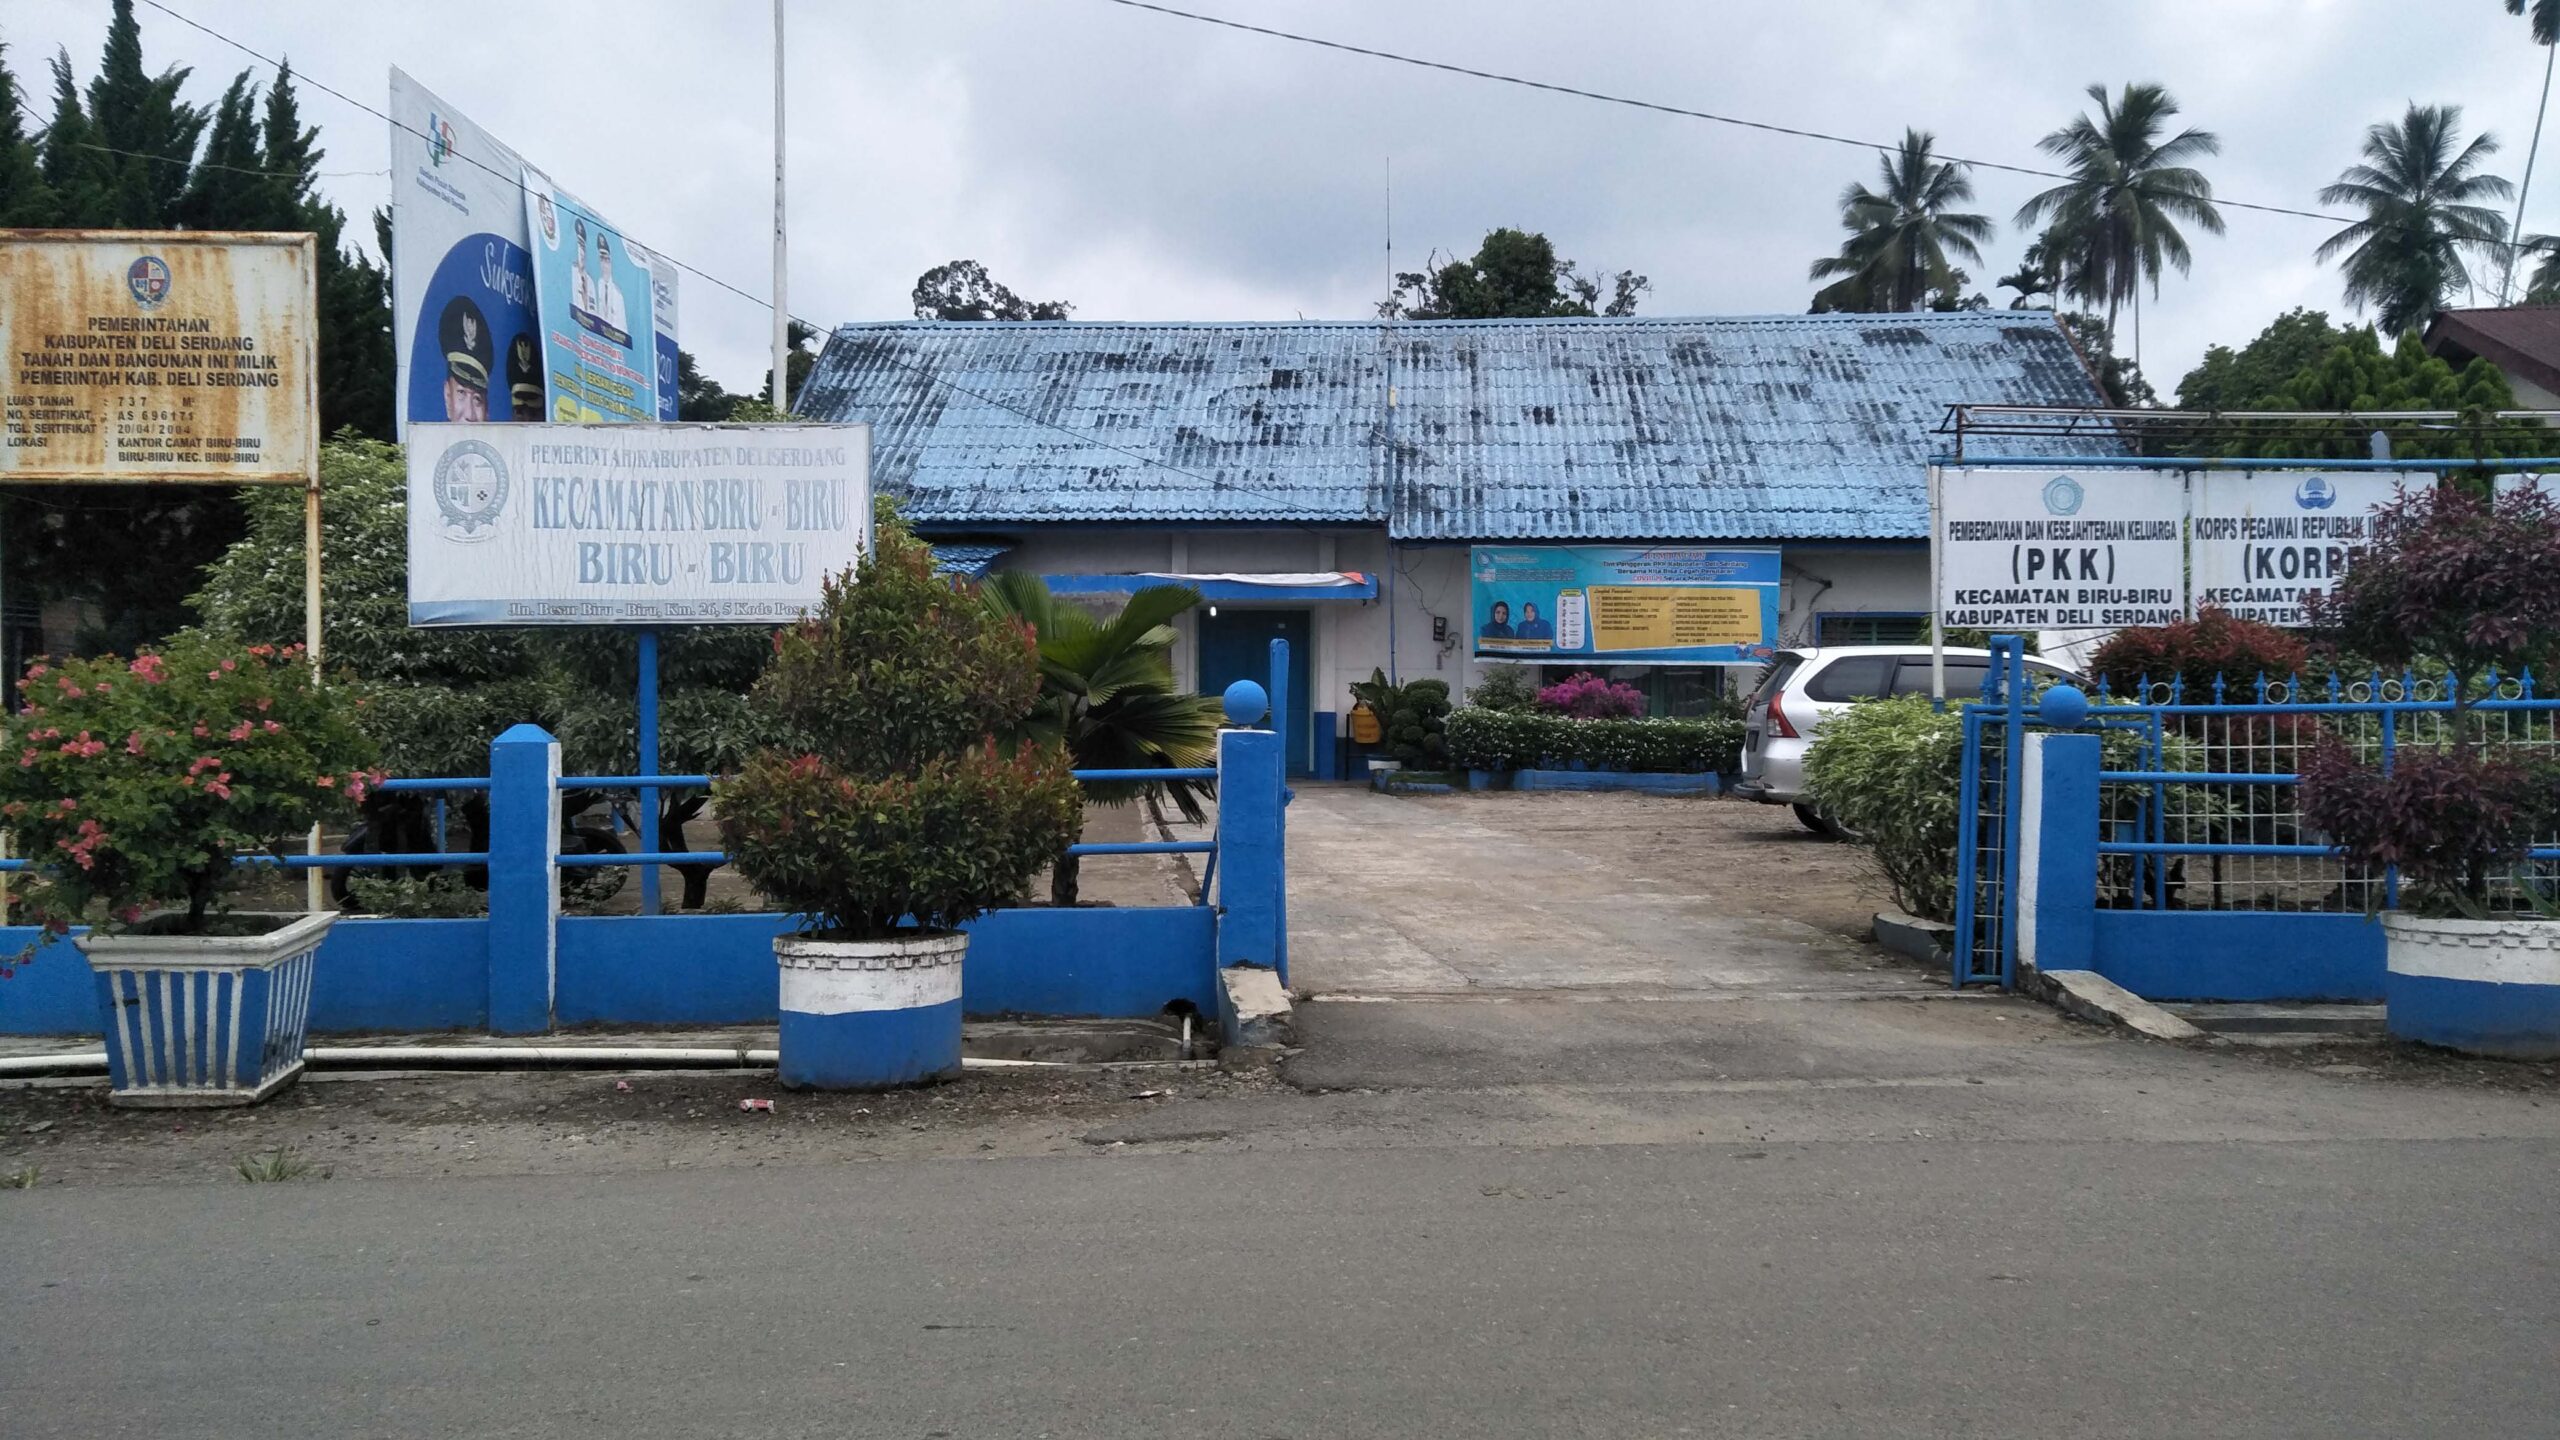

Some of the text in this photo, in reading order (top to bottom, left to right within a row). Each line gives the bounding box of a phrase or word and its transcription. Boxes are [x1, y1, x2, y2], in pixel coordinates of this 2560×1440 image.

[88, 317, 210, 332] PEMERINTAHAN
[44, 334, 254, 351] KABUPATEN DELI SERDANG
[22, 352, 278, 369] TANAH DAN BANGUNAN INI MILIK
[20, 371, 279, 387] PEMERINTAH KAB. DELI SERDANG
[6, 395, 35, 407] LUAS
[38, 396, 74, 407] TANAH
[7, 410, 25, 420] NO.
[117, 411, 135, 421] AS
[7, 423, 31, 434] TGL.
[34, 424, 97, 434] SERTIFIKAT
[7, 437, 48, 448] LOKASI
[117, 438, 162, 448] KANTOR
[165, 438, 203, 448] CAMAT
[206, 438, 262, 449] BIRU-BIRU
[118, 451, 260, 463] BIRU-BIRU KEC. BIRU-BIRU
[531, 444, 632, 468] PEMERINTAH
[637, 447, 732, 469] KABUPATEN
[533, 476, 697, 532] KECAMATAN
[702, 478, 764, 532] BIRU
[785, 478, 846, 532] BIRU
[1949, 520, 2178, 541] PEMBERDAYAAN DAN KESEJAHTERAAN KELUARGA
[2195, 516, 2238, 540] KORPS
[2240, 516, 2299, 539] PEGAWAI
[577, 541, 674, 586] BIRU
[708, 541, 807, 586] BIRU
[1955, 588, 2173, 605] KECAMATAN BIRU-BIRU
[507, 602, 535, 617] Jln.
[537, 602, 579, 617] Besar
[580, 602, 614, 617] Biru
[625, 602, 662, 618] Biru,
[665, 602, 696, 617] Km.
[698, 601, 720, 618] 26,
[722, 601, 732, 616] 5
[734, 602, 773, 617] Kode
[1945, 609, 2182, 625] KABUPATEN DELI SERDANG
